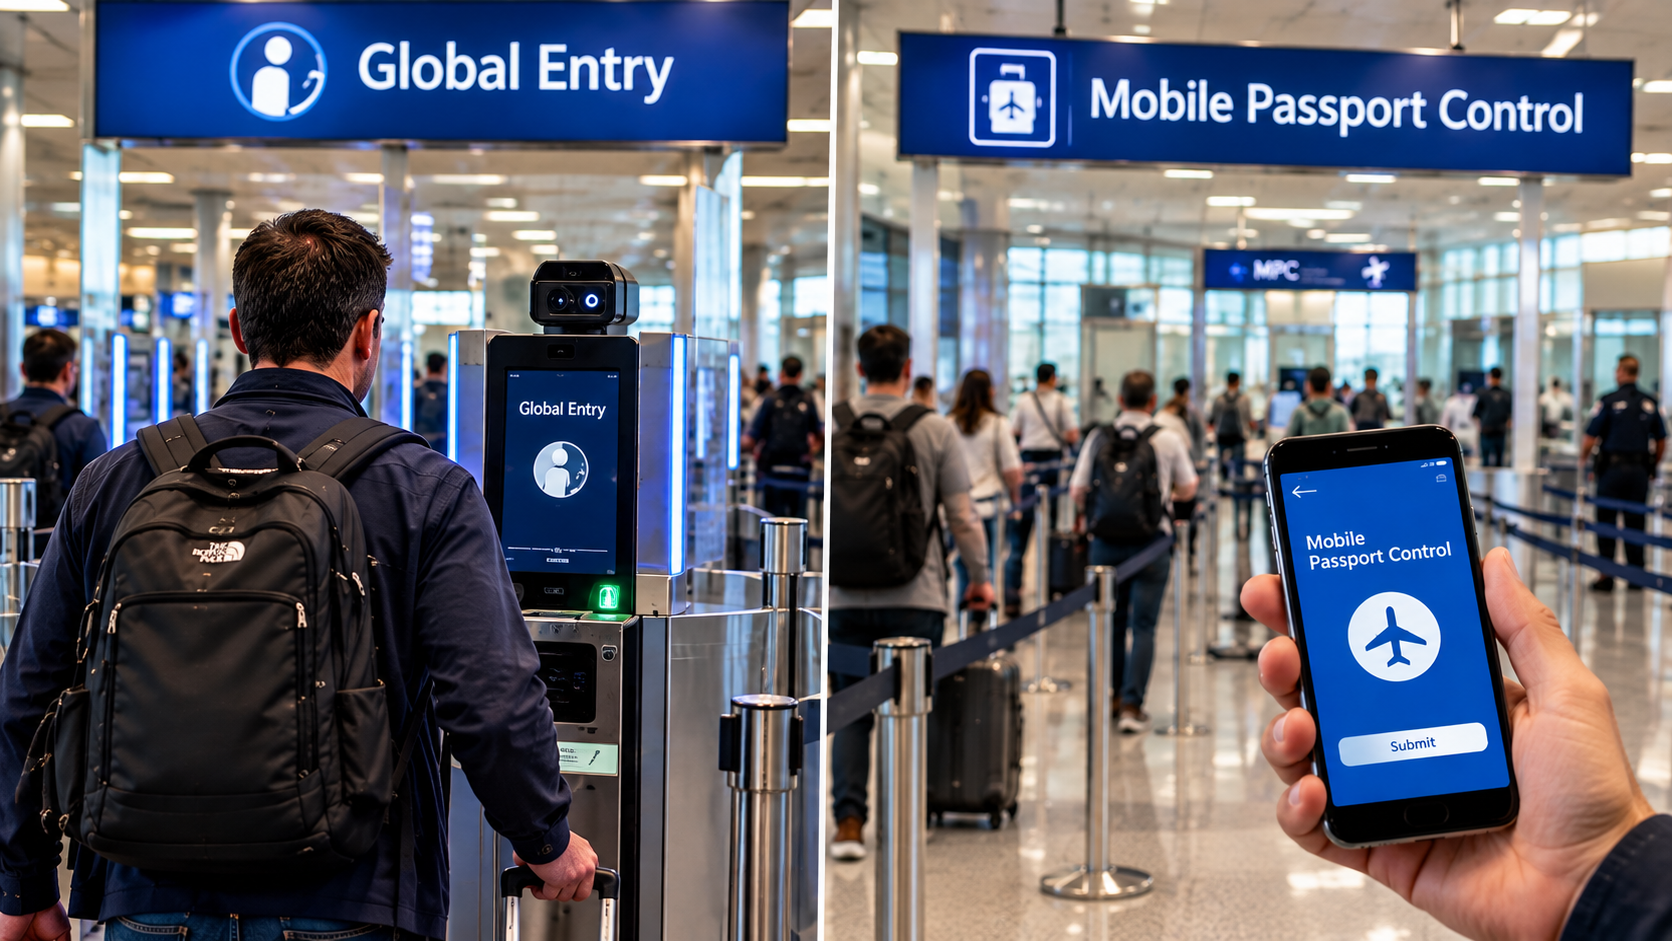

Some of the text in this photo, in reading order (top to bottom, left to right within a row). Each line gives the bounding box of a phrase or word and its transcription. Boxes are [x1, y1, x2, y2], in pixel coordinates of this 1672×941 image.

[358, 40, 675, 105] Global Entry
[1090, 77, 1584, 138] Mobile Passport Control
[1253, 259, 1300, 281] MPC
[519, 400, 607, 420] Global Entry
[1306, 531, 1366, 551] Mobile
[1309, 540, 1452, 571] Passport Control
[1390, 736, 1437, 753] Submit
